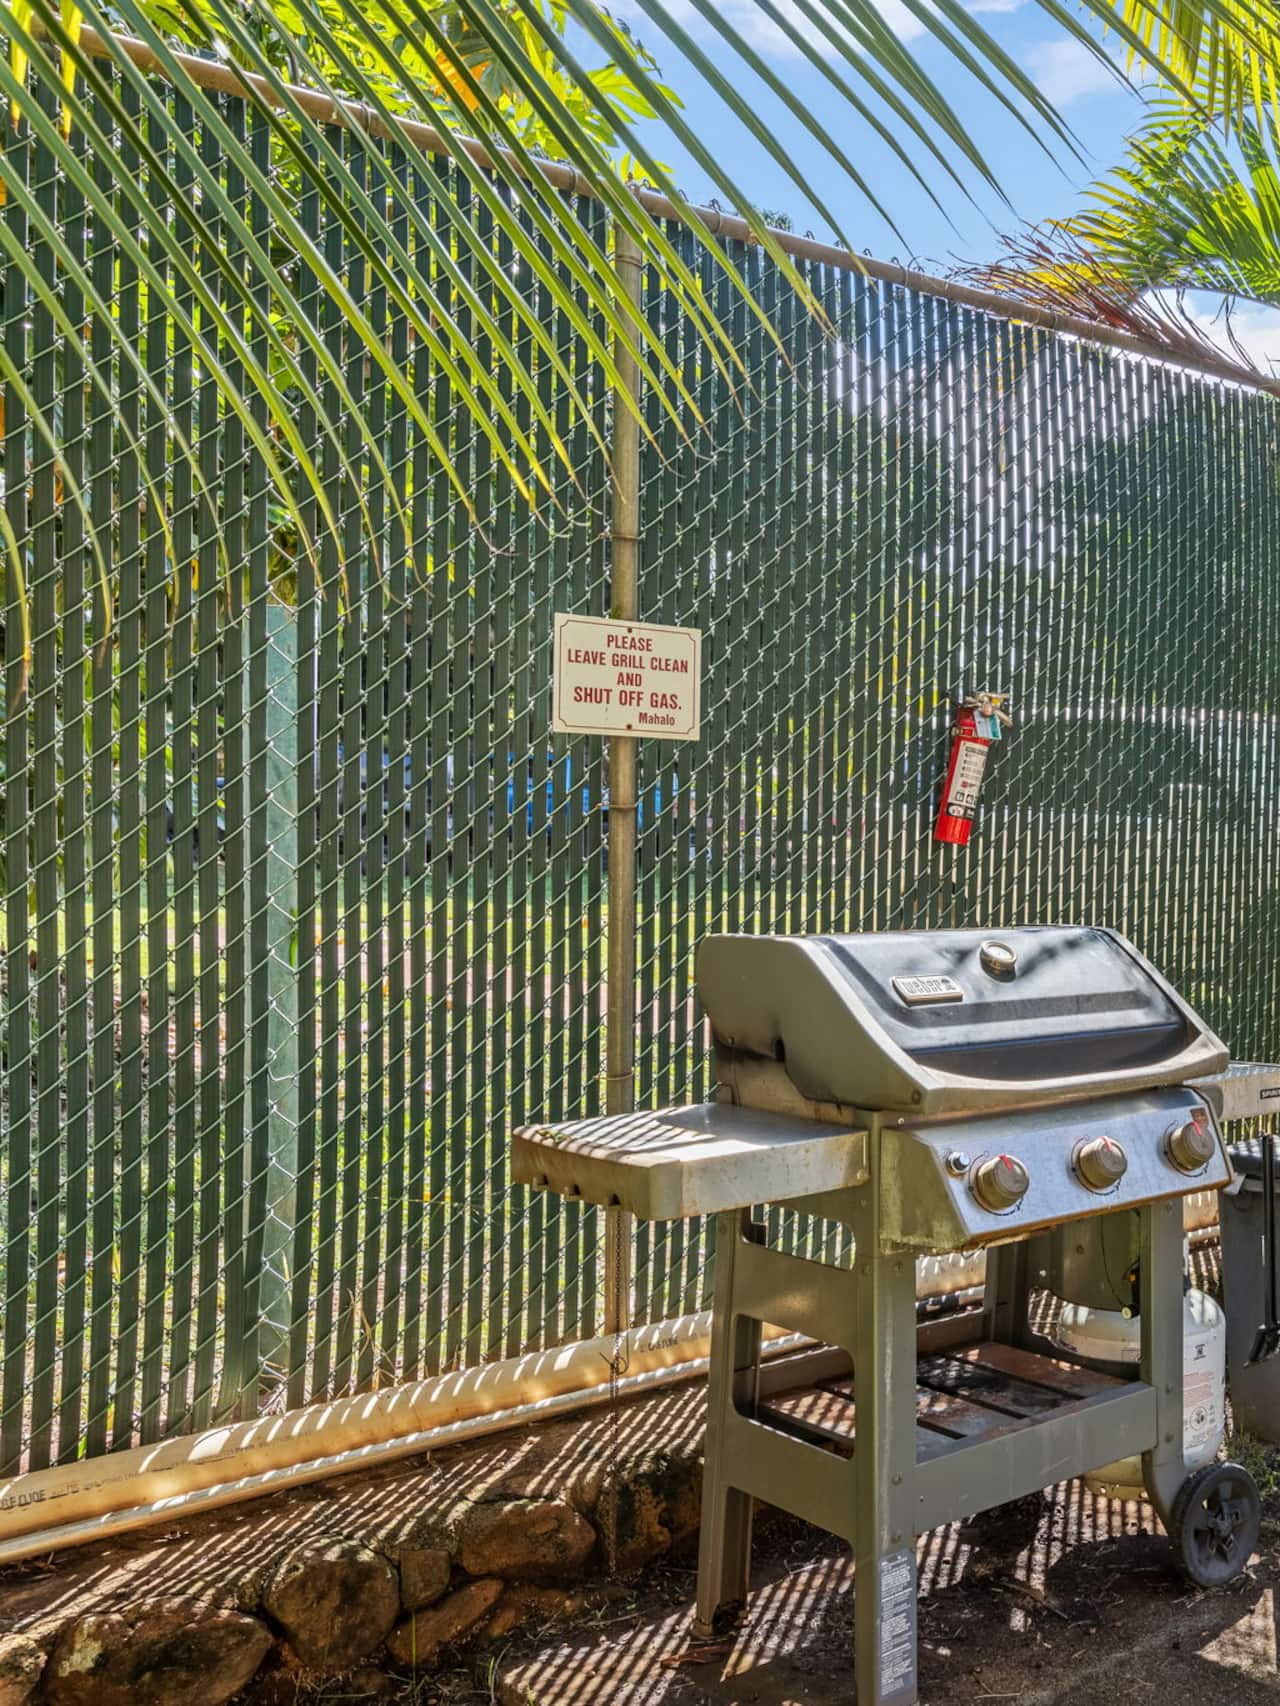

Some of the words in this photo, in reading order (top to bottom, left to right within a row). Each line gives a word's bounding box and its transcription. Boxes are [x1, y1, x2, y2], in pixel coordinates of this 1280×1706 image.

[607, 634, 653, 651] PLEASE
[568, 648, 606, 666] LEAVE
[612, 653, 646, 670] GRILL
[650, 657, 688, 673] CLEAN
[617, 672, 642, 687] AND
[574, 686, 613, 705] SHUT
[619, 690, 645, 707] OFF
[650, 692, 682, 710] GAS.
[638, 712, 675, 726] Mahalo
